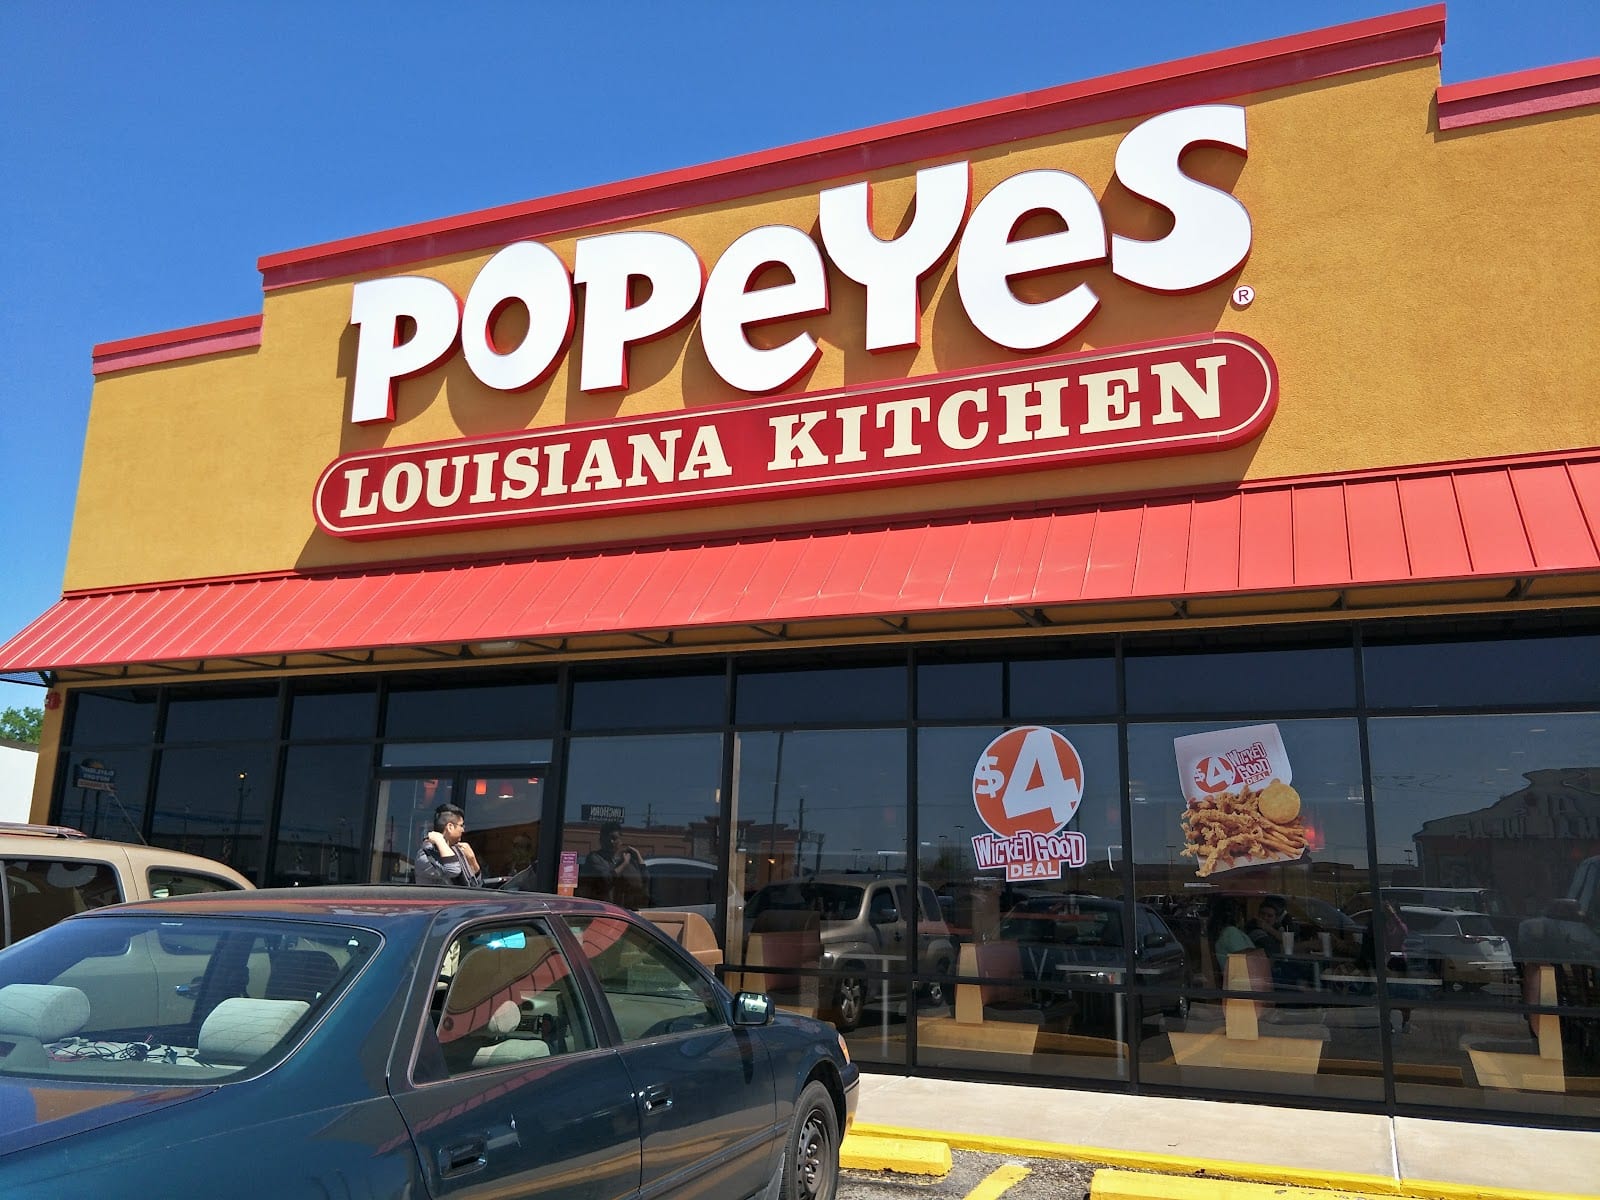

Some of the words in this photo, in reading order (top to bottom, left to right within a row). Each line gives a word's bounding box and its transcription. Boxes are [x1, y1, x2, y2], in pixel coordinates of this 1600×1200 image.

[339, 424, 732, 518] LOUISIANA
[767, 355, 1227, 471] KITCHEN
[1226, 742, 1267, 766] WICKED
[975, 728, 1080, 825] $4
[1236, 759, 1272, 779] GOOD
[1246, 771, 1271, 785] DEAL
[974, 832, 1033, 866] WICKED
[1034, 834, 1085, 865] GOOD
[1010, 863, 1058, 878] DEAL
